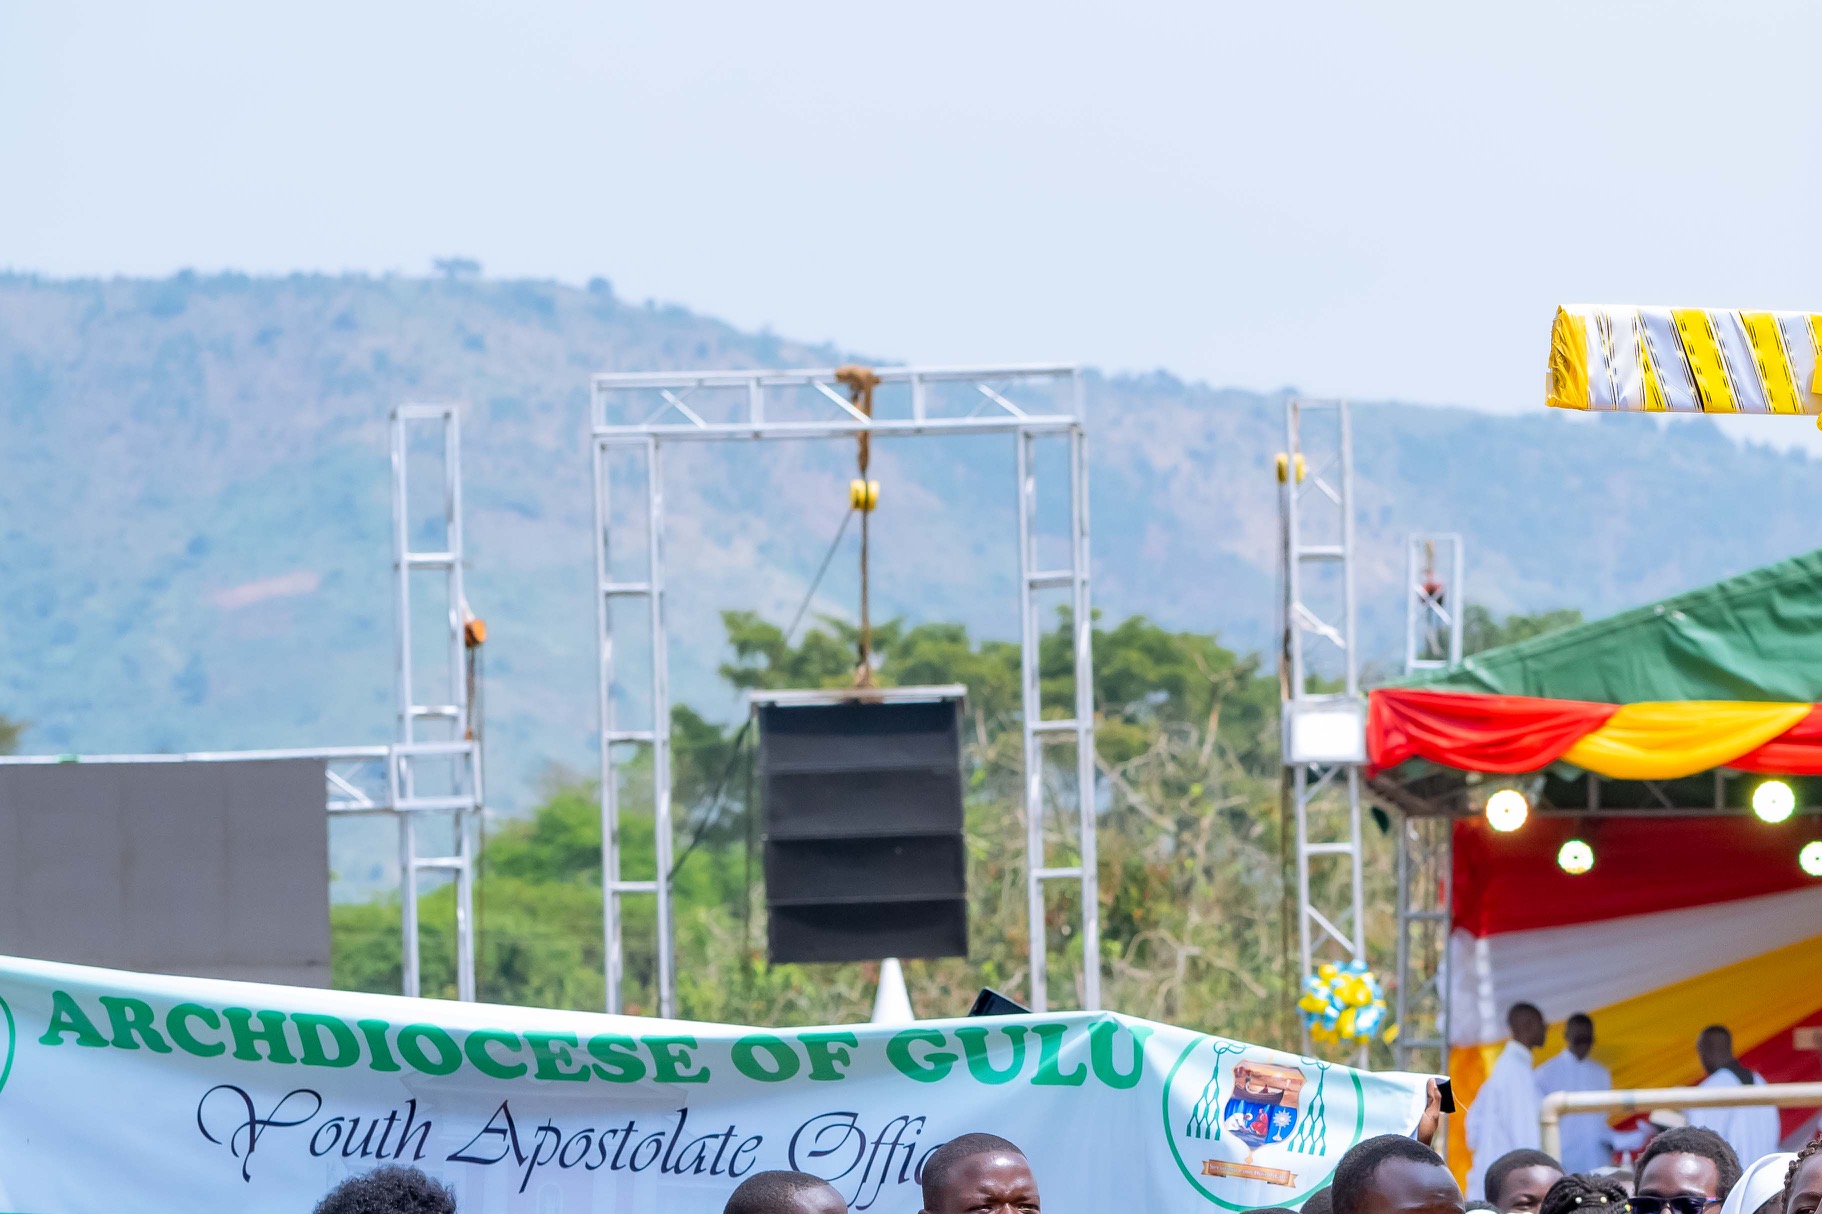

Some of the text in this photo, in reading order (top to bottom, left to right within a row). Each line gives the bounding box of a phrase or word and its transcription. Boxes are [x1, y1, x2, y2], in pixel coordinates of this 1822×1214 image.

[38, 990, 1154, 1090] ARCHDIOCESE OF GULU
[197, 1084, 433, 1183] Youth
[446, 1100, 763, 1194] Apostolate
